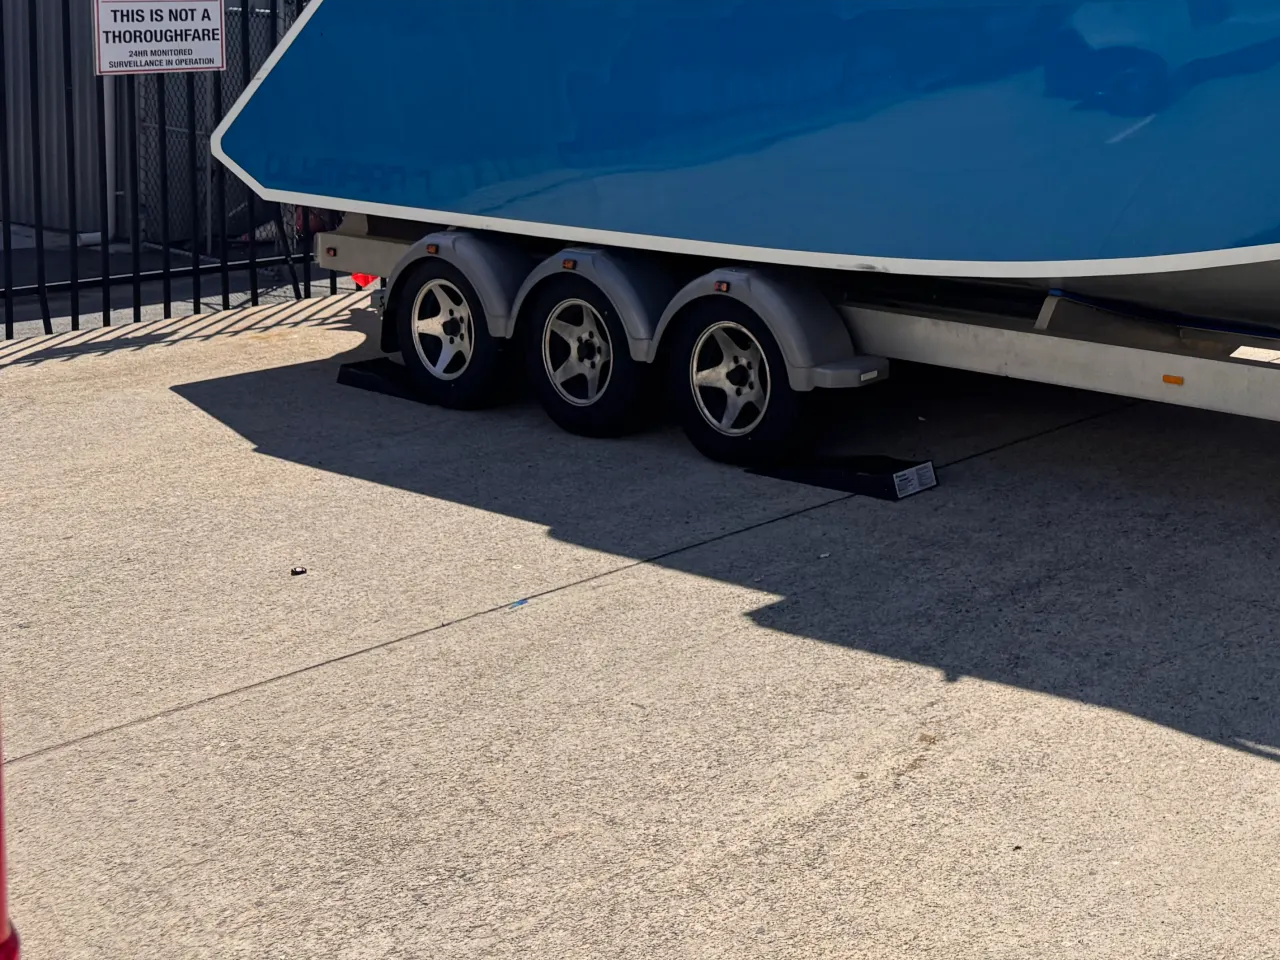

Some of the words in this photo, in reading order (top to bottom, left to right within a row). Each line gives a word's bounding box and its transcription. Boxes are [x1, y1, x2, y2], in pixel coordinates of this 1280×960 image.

[111, 9, 145, 22] THIS
[150, 9, 164, 22] IS
[168, 8, 197, 22] NOT
[201, 8, 211, 21] A
[102, 28, 220, 43] THOROUGHFARE
[128, 50, 148, 58] 24HR
[150, 48, 193, 57] MONITORED
[108, 60, 164, 68] SURVEILLANCE
[165, 59, 174, 67] IN
[175, 58, 215, 66] OPERATION
